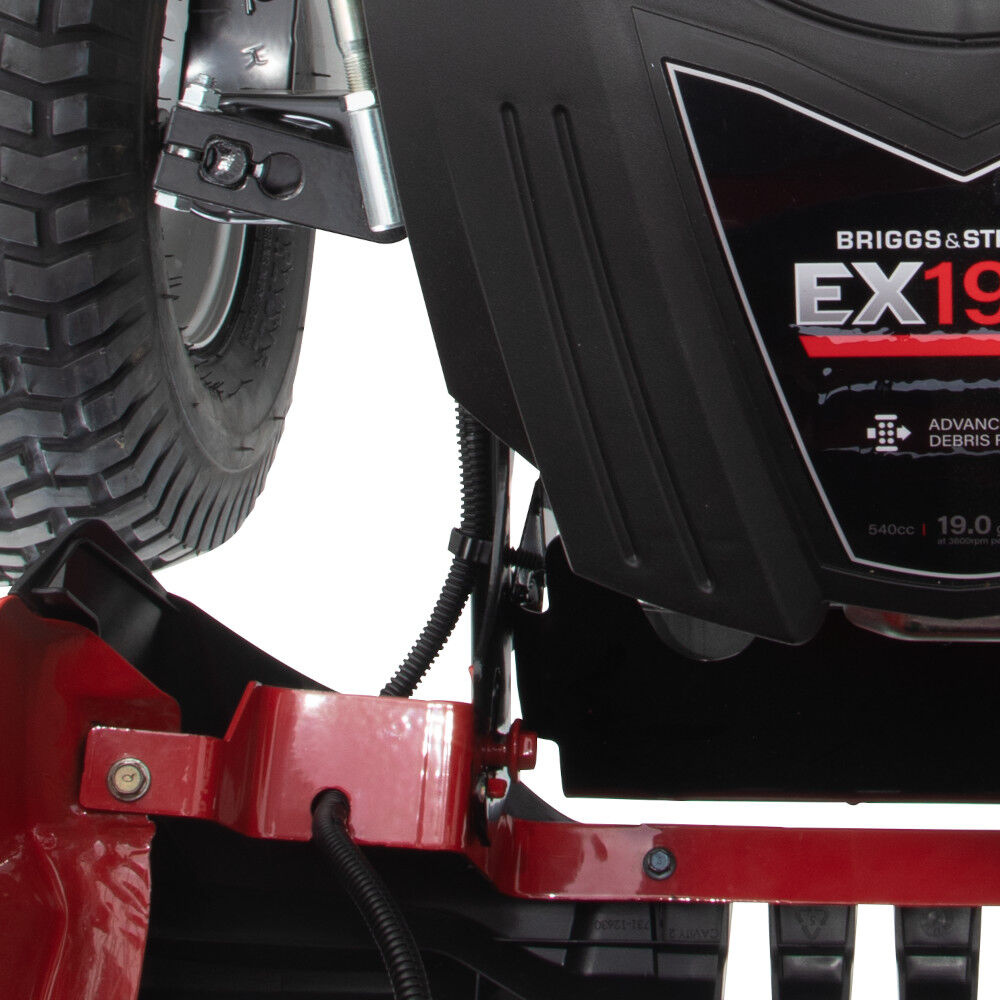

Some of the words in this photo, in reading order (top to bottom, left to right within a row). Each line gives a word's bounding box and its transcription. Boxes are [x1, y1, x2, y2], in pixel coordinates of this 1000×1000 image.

[929, 433, 991, 447] DEBRIS
[868, 523, 915, 536] 540cc
[937, 514, 992, 536] 19.0
